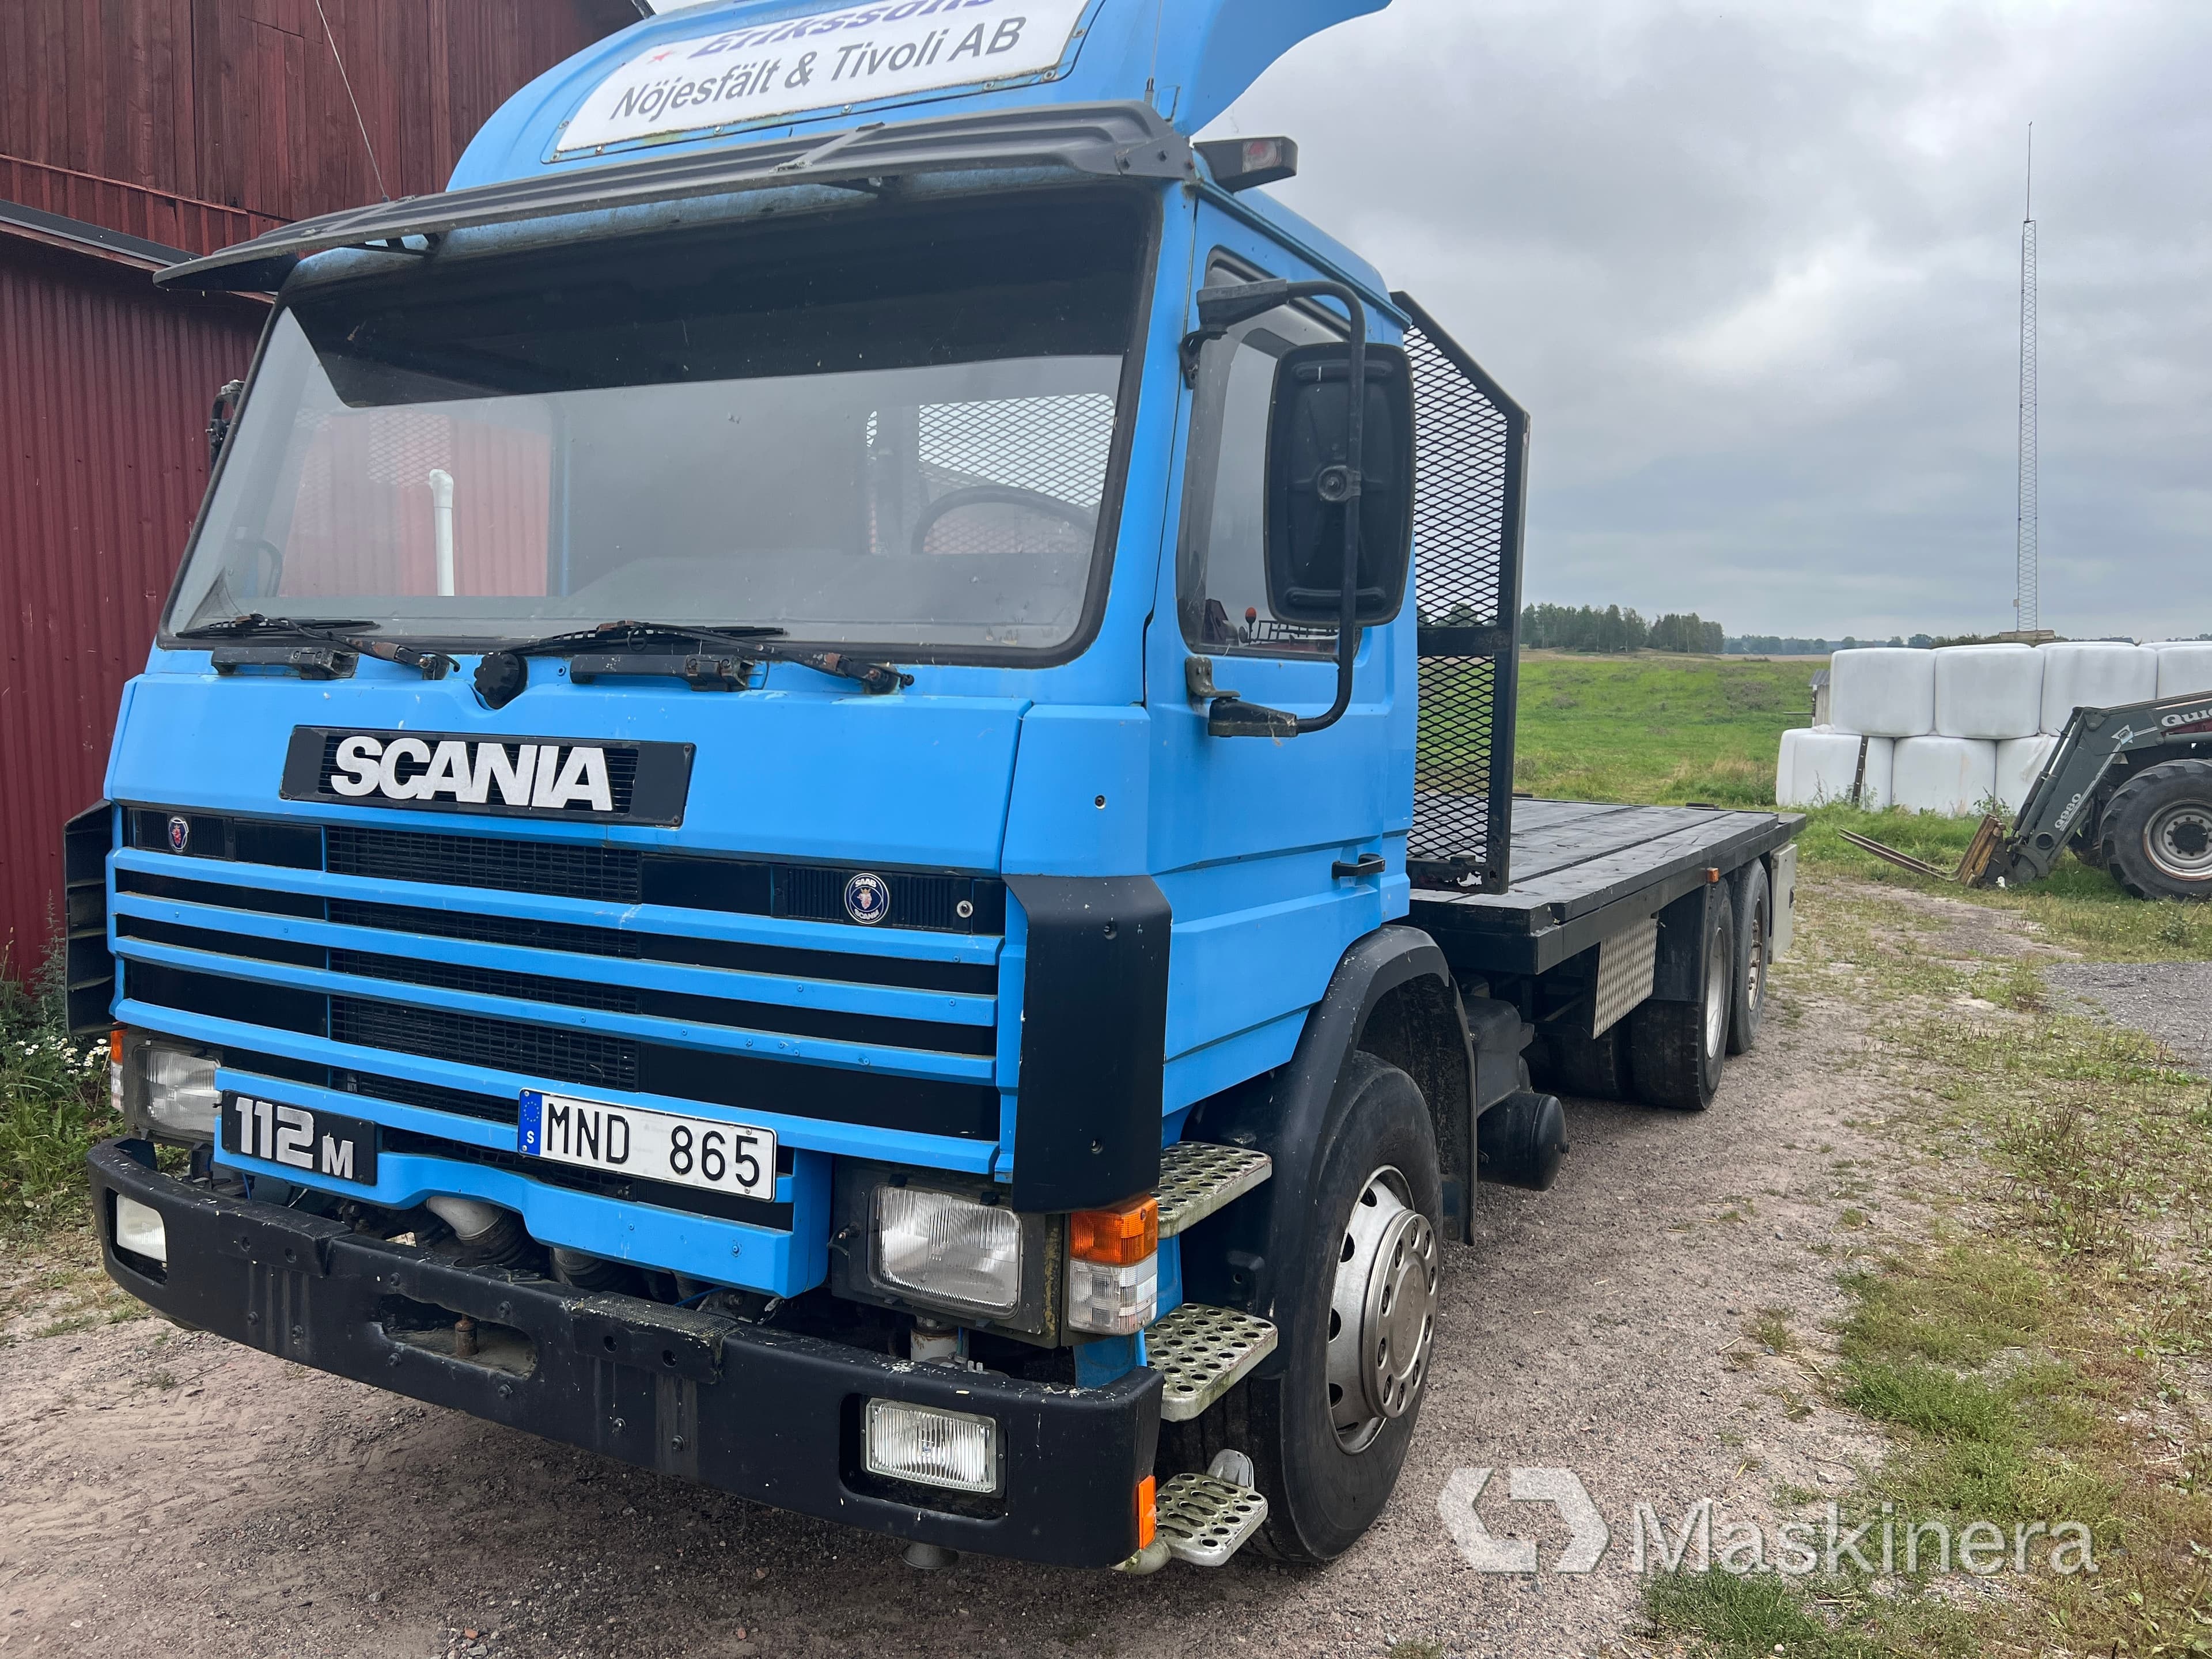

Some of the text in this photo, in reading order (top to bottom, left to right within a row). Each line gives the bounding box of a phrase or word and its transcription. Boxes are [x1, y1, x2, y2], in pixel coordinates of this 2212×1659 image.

[609, 16, 1027, 122] Nöjesfält & Tivoli AB
[2161, 708, 2212, 727] Qui
[330, 735, 613, 811] SCANIA
[854, 878, 877, 888] SAAB
[854, 908, 880, 921] SCANIA
[234, 1096, 354, 1180] 112 M
[526, 1130, 535, 1144] S
[547, 1103, 760, 1188] MND 865
